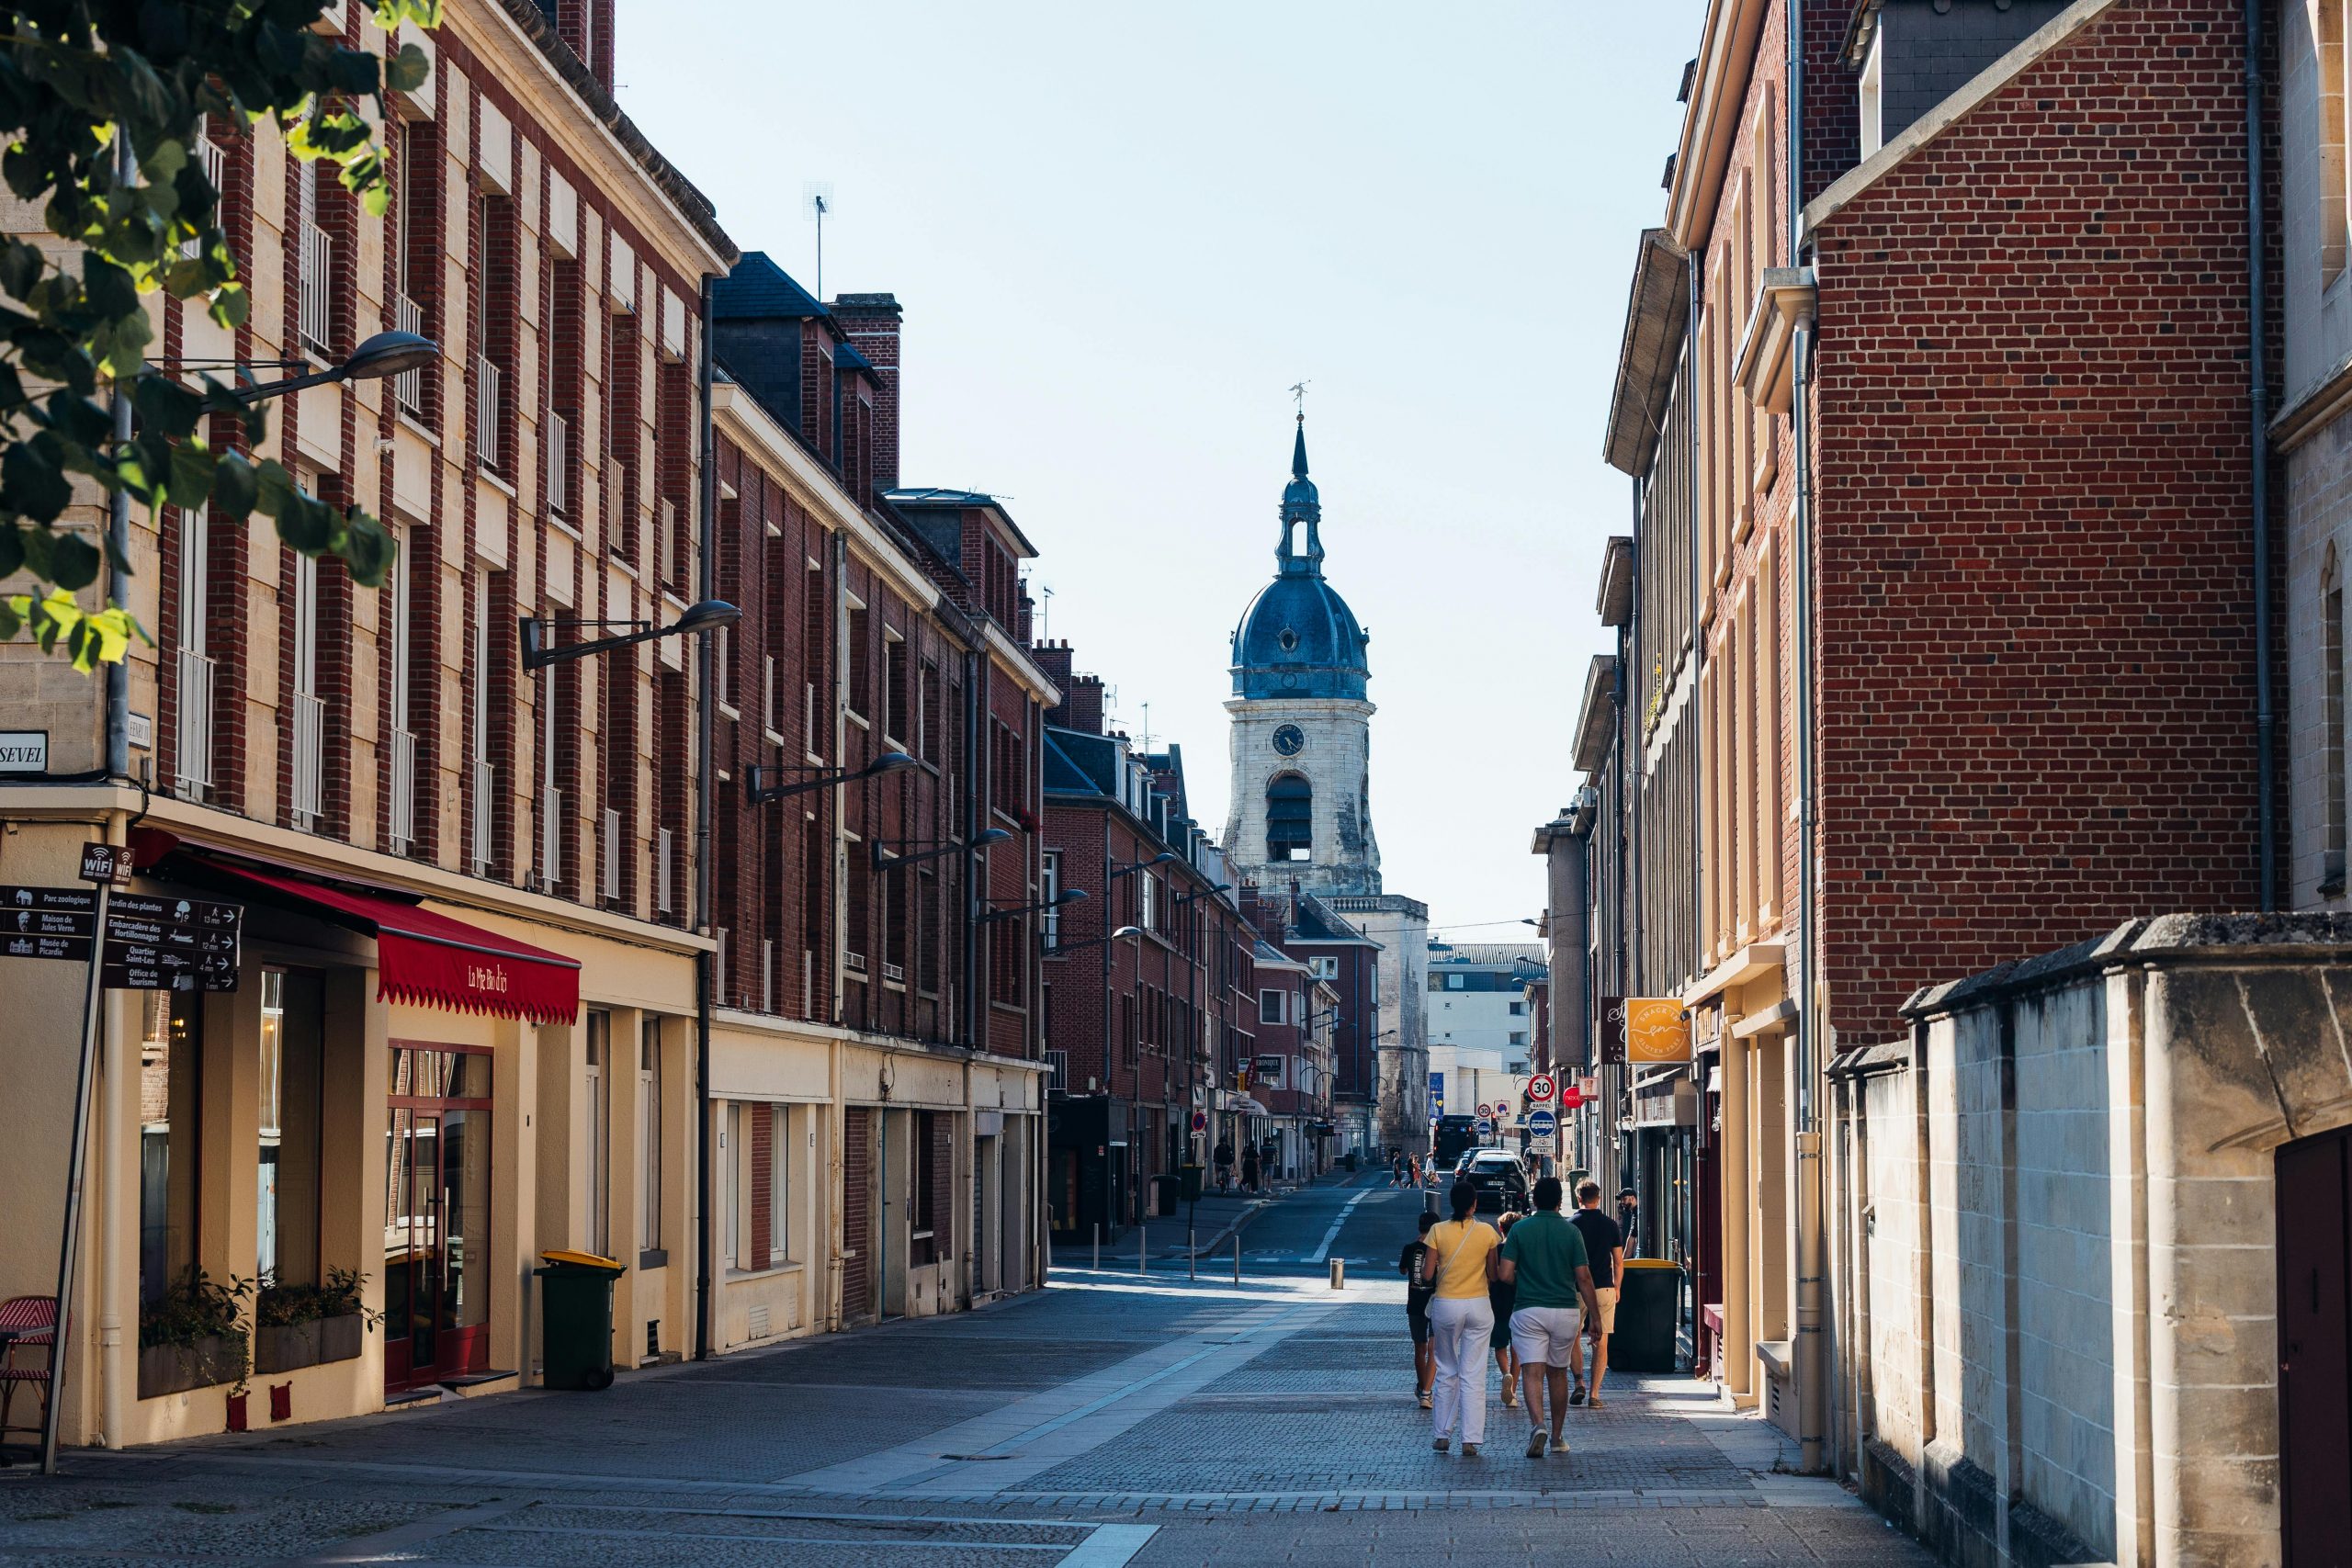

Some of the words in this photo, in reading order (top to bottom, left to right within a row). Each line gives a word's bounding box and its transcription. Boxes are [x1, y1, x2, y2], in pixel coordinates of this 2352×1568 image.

[0, 747, 43, 763] SEVEL
[44, 894, 57, 902] Parc
[58, 895, 91, 905] zoologique
[107, 898, 127, 908] Jardin
[128, 900, 138, 909] des
[140, 901, 163, 912] plantes
[41, 914, 64, 923] Maison
[65, 916, 73, 924] de
[204, 916, 210, 924] 13
[41, 922, 56, 931] Jules
[57, 924, 75, 932] Verne
[108, 919, 149, 931] Embarcadère
[150, 923, 161, 933] des
[114, 929, 160, 942] Hortillonnages
[40, 938, 60, 947] Musée
[61, 940, 69, 948] de
[202, 942, 209, 950] 12
[39, 947, 63, 955] Picardie
[130, 946, 156, 956] Quartier
[126, 954, 155, 964] Saint-Leu
[129, 968, 149, 977] Office
[150, 969, 158, 977] de
[469, 965, 476, 987] La
[129, 977, 158, 987] Tourisme
[1638, 1037, 1664, 1054] GLUTEN
[1256, 1059, 1279, 1067] ERONIQUE
[1247, 1066, 1255, 1086] TABAC
[1534, 1082, 1550, 1094] 30
